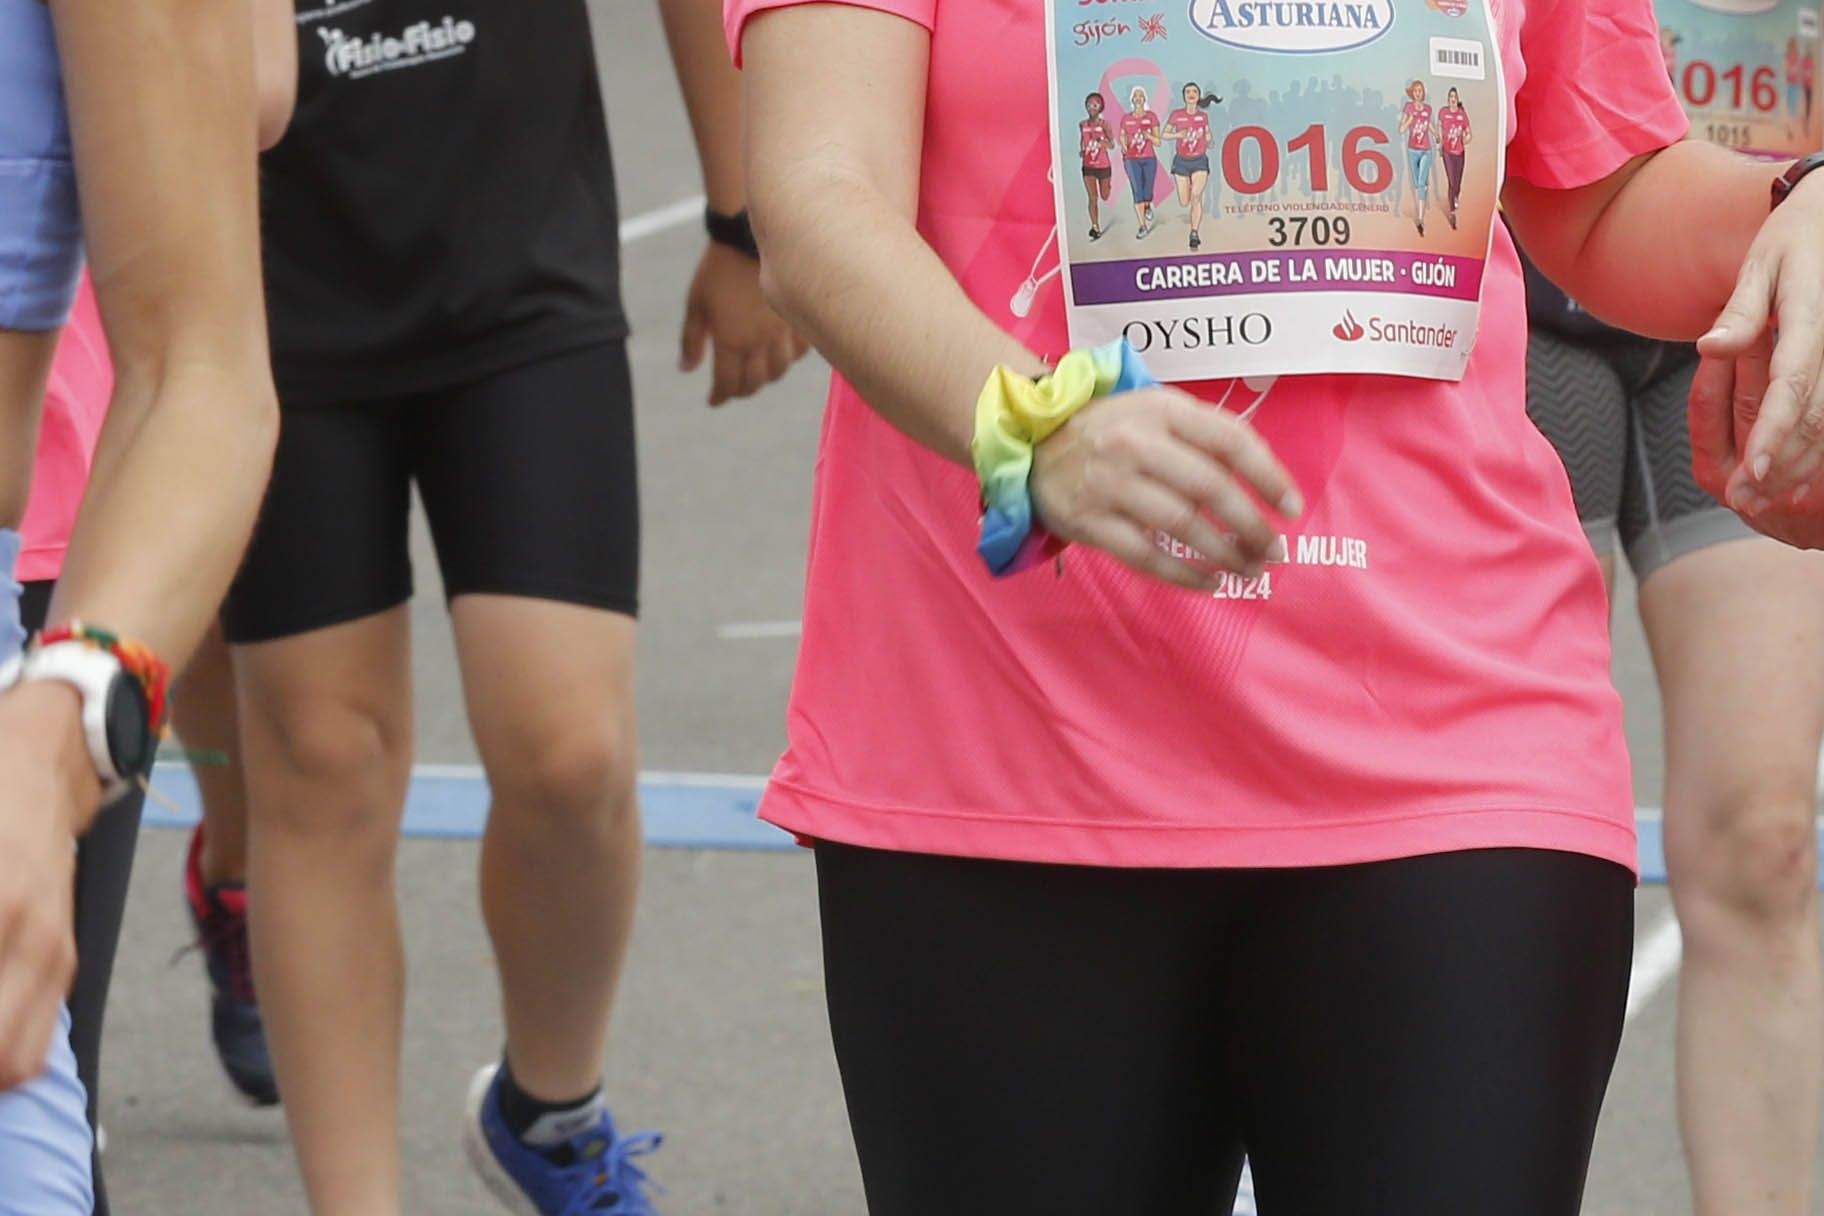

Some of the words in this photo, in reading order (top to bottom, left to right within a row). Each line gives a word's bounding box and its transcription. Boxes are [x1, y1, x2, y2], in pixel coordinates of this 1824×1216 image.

[1681, 59, 1778, 112] 016
[1220, 123, 1394, 195] 016
[1267, 216, 1351, 247] 3709
[1136, 260, 1242, 292] CARRERA
[1250, 260, 1281, 284] DE
[1288, 259, 1318, 282] LA
[1324, 257, 1395, 283] MUJER
[1411, 257, 1457, 288] GIJÓN
[1122, 312, 1273, 353] OYSHO
[1369, 317, 1458, 349] Santander
[1297, 535, 1368, 569] MUJER
[1213, 570, 1272, 600] 2024
